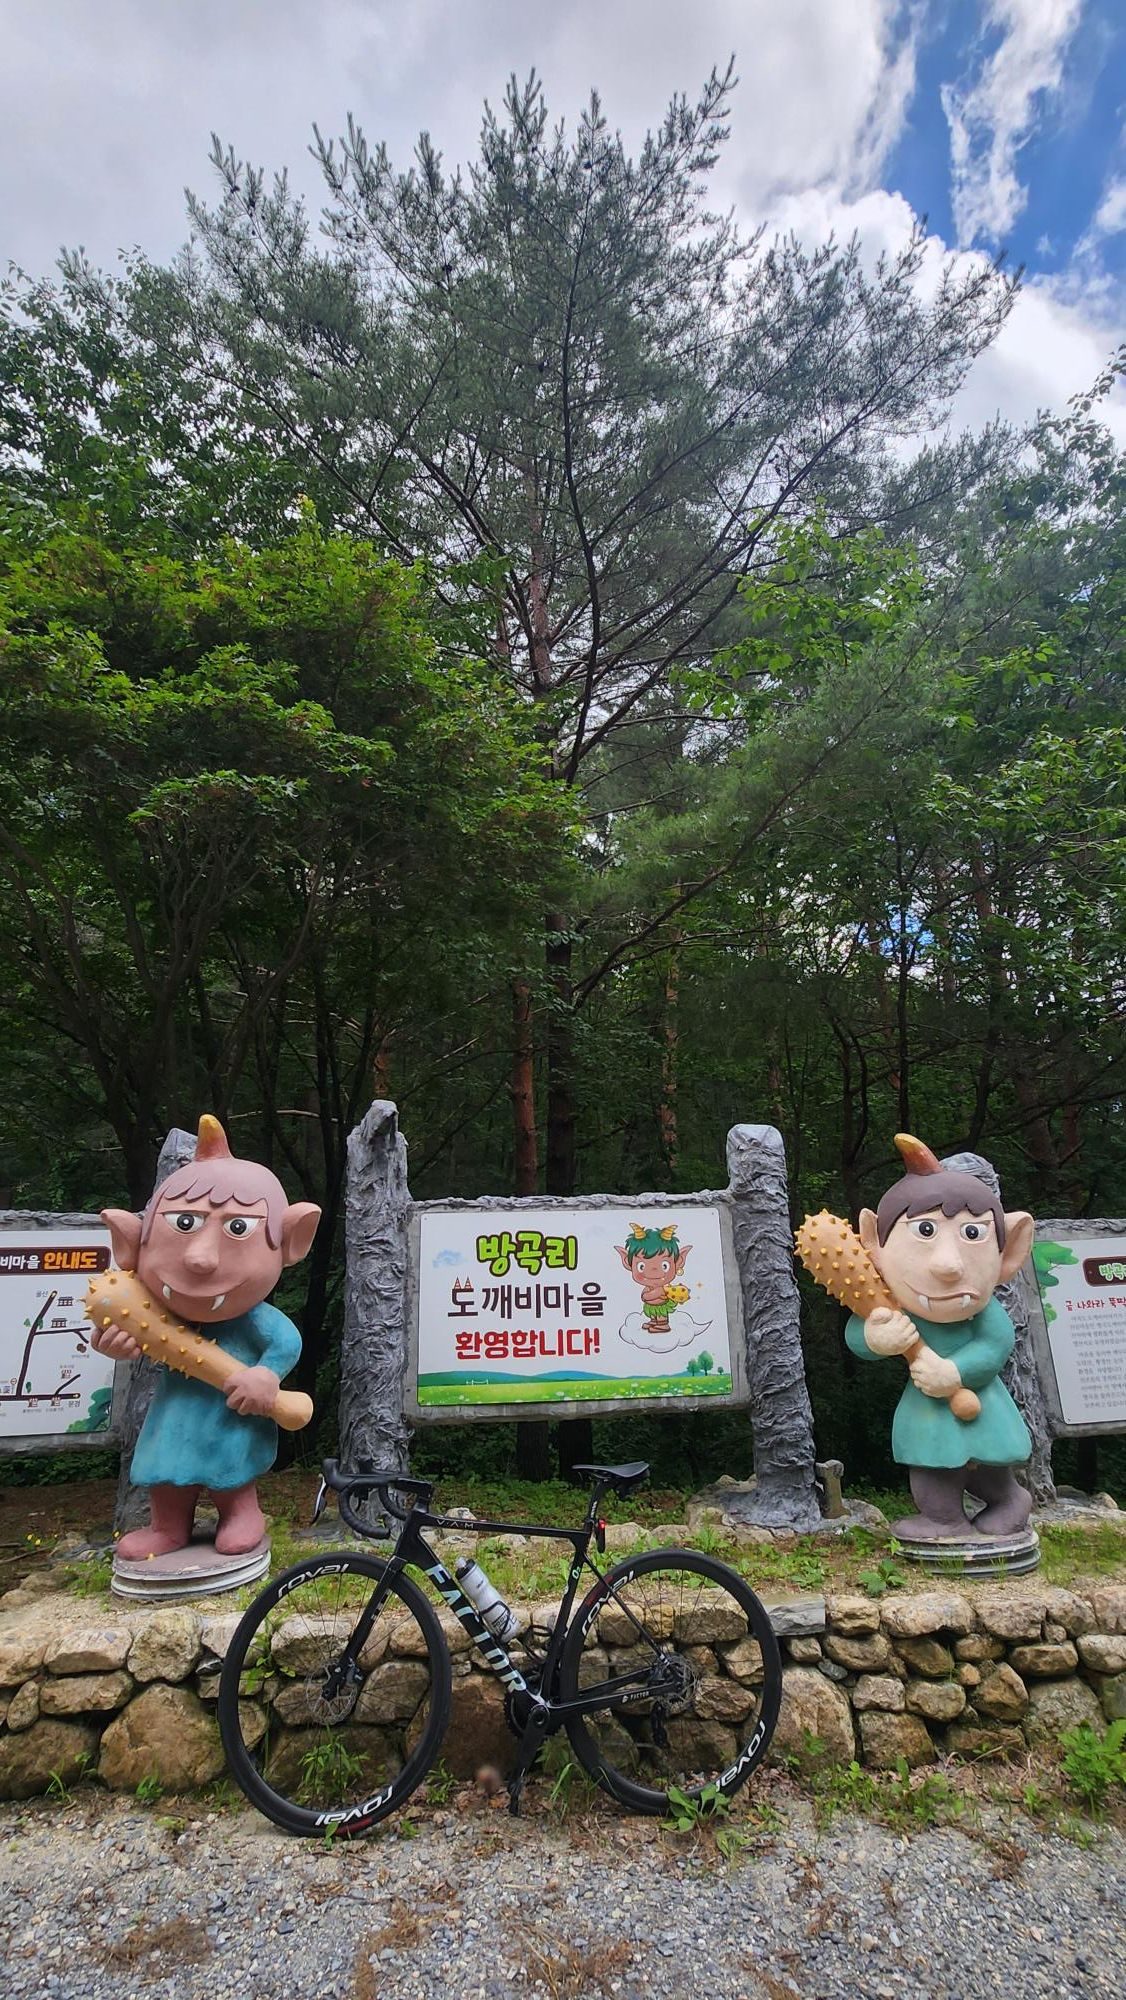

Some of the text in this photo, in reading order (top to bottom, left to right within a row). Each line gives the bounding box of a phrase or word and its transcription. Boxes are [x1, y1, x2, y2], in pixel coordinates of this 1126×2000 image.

[44, 1251, 98, 1270] 안내도
[476, 1230, 578, 1277] 방곡리
[1099, 1263, 1126, 1281] 방곡
[447, 1281, 608, 1320] 도깨비마을
[1077, 1299, 1105, 1310] 나와라
[455, 1327, 601, 1360] 환영합니다!
[278, 1563, 350, 1598] roval
[314, 1785, 393, 1826] roval
